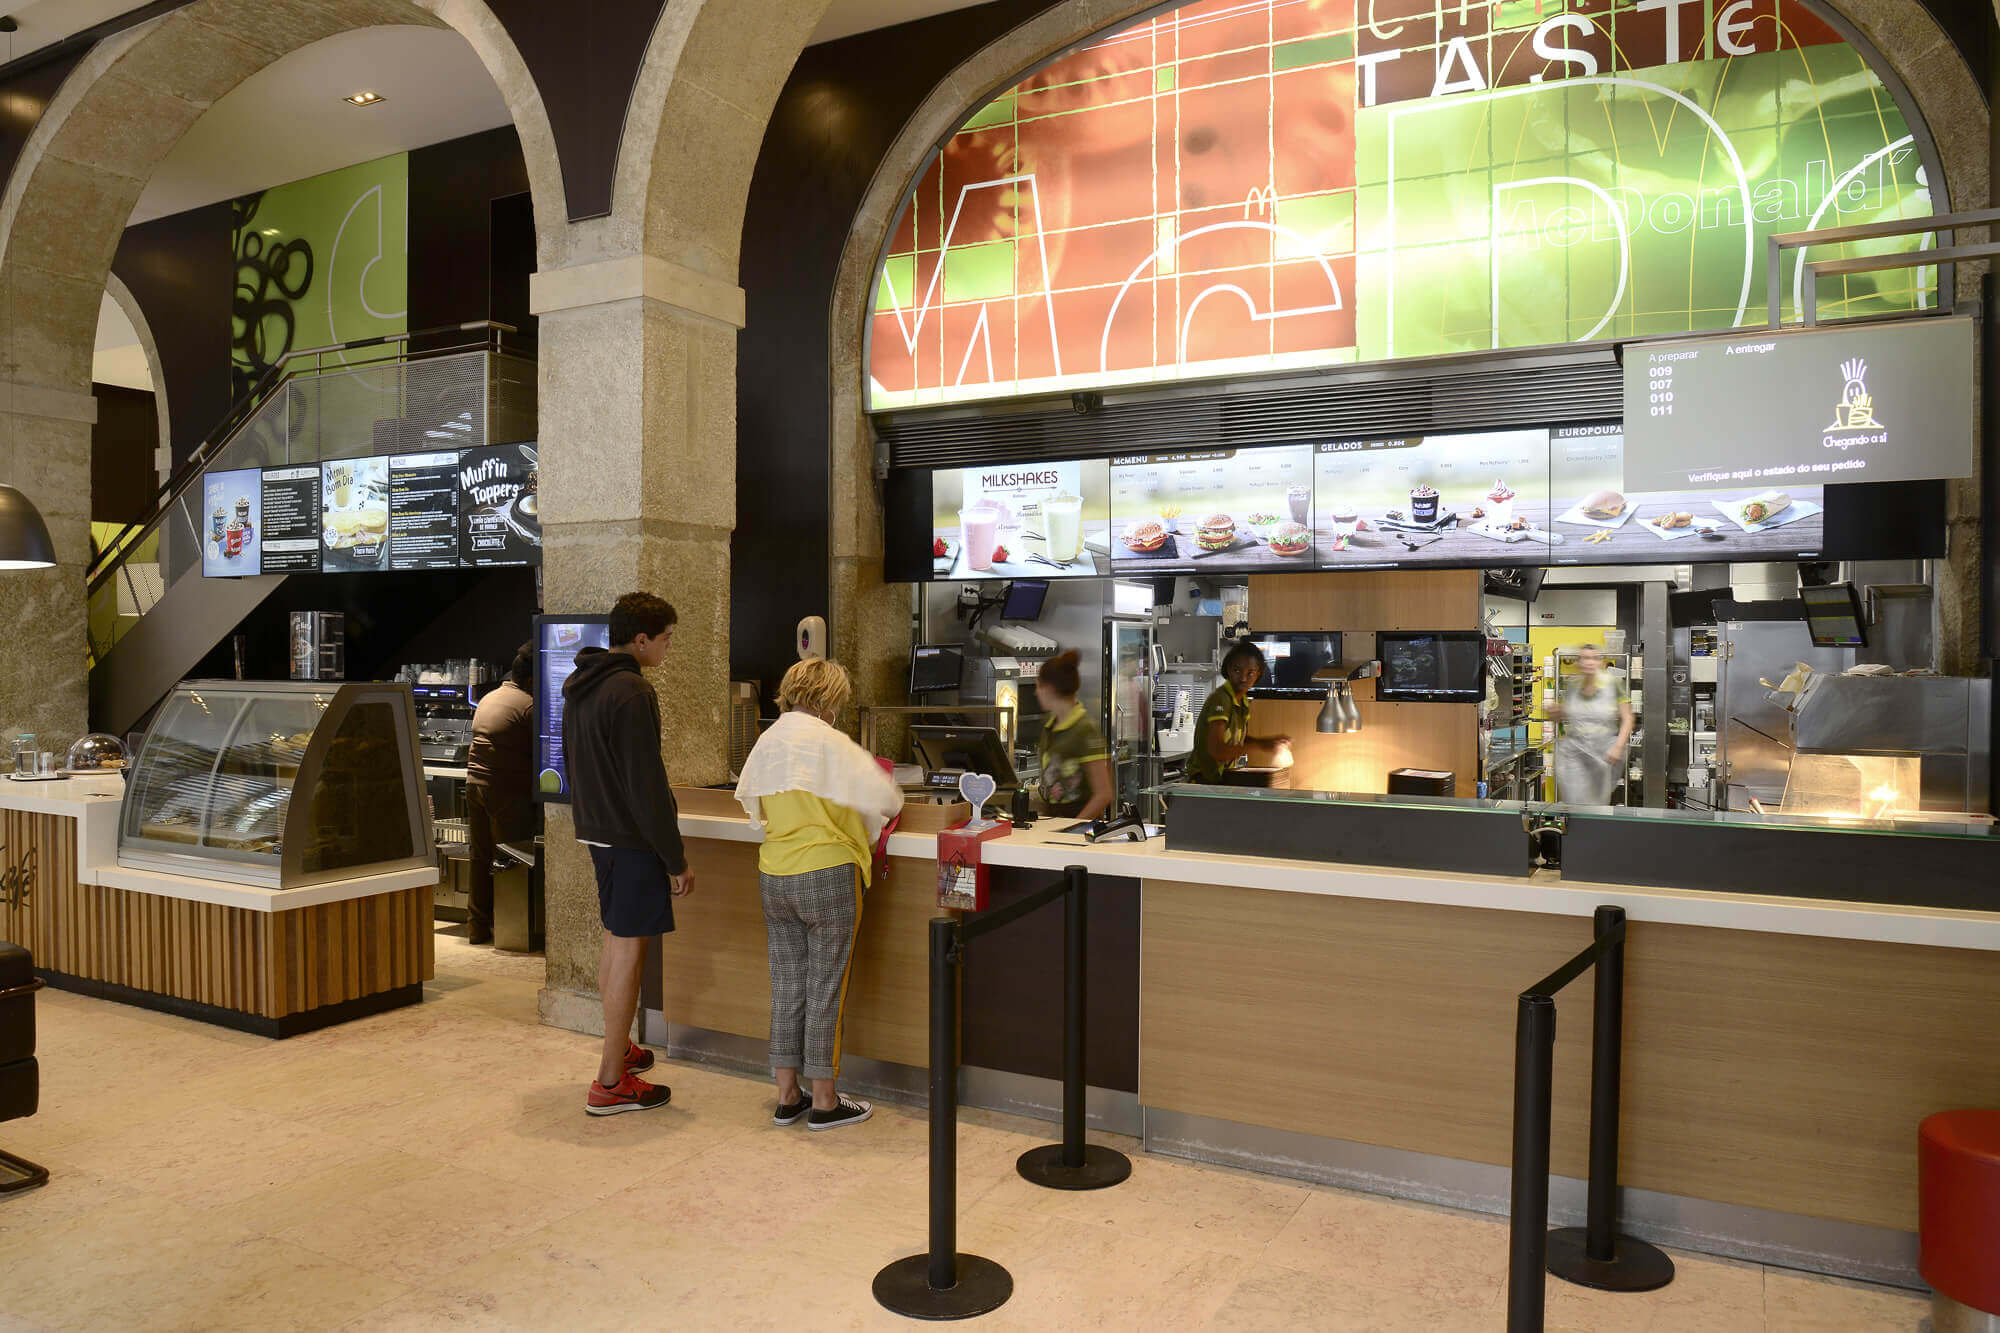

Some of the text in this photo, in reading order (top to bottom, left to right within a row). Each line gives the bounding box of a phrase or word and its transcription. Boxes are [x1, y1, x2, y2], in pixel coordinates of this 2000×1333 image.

[1725, 342, 1776, 355] A entregar
[1649, 350, 1698, 364] A preparar
[1649, 366, 1672, 377] 009
[1649, 379, 1672, 390] 007
[1650, 392, 1673, 403] 010
[1650, 405, 1672, 416] 011
[1559, 425, 1624, 437] EUROPOUPA
[1321, 441, 1363, 451] GELADOS
[1823, 436, 1869, 450] Chegando
[1113, 455, 1148, 465] McMENU
[460, 457, 508, 491] Muffin
[1688, 459, 1866, 483] Verifique aqui o estado do seu pedido
[982, 470, 1058, 488] MILKSHAKES
[469, 483, 520, 505] Toppers
